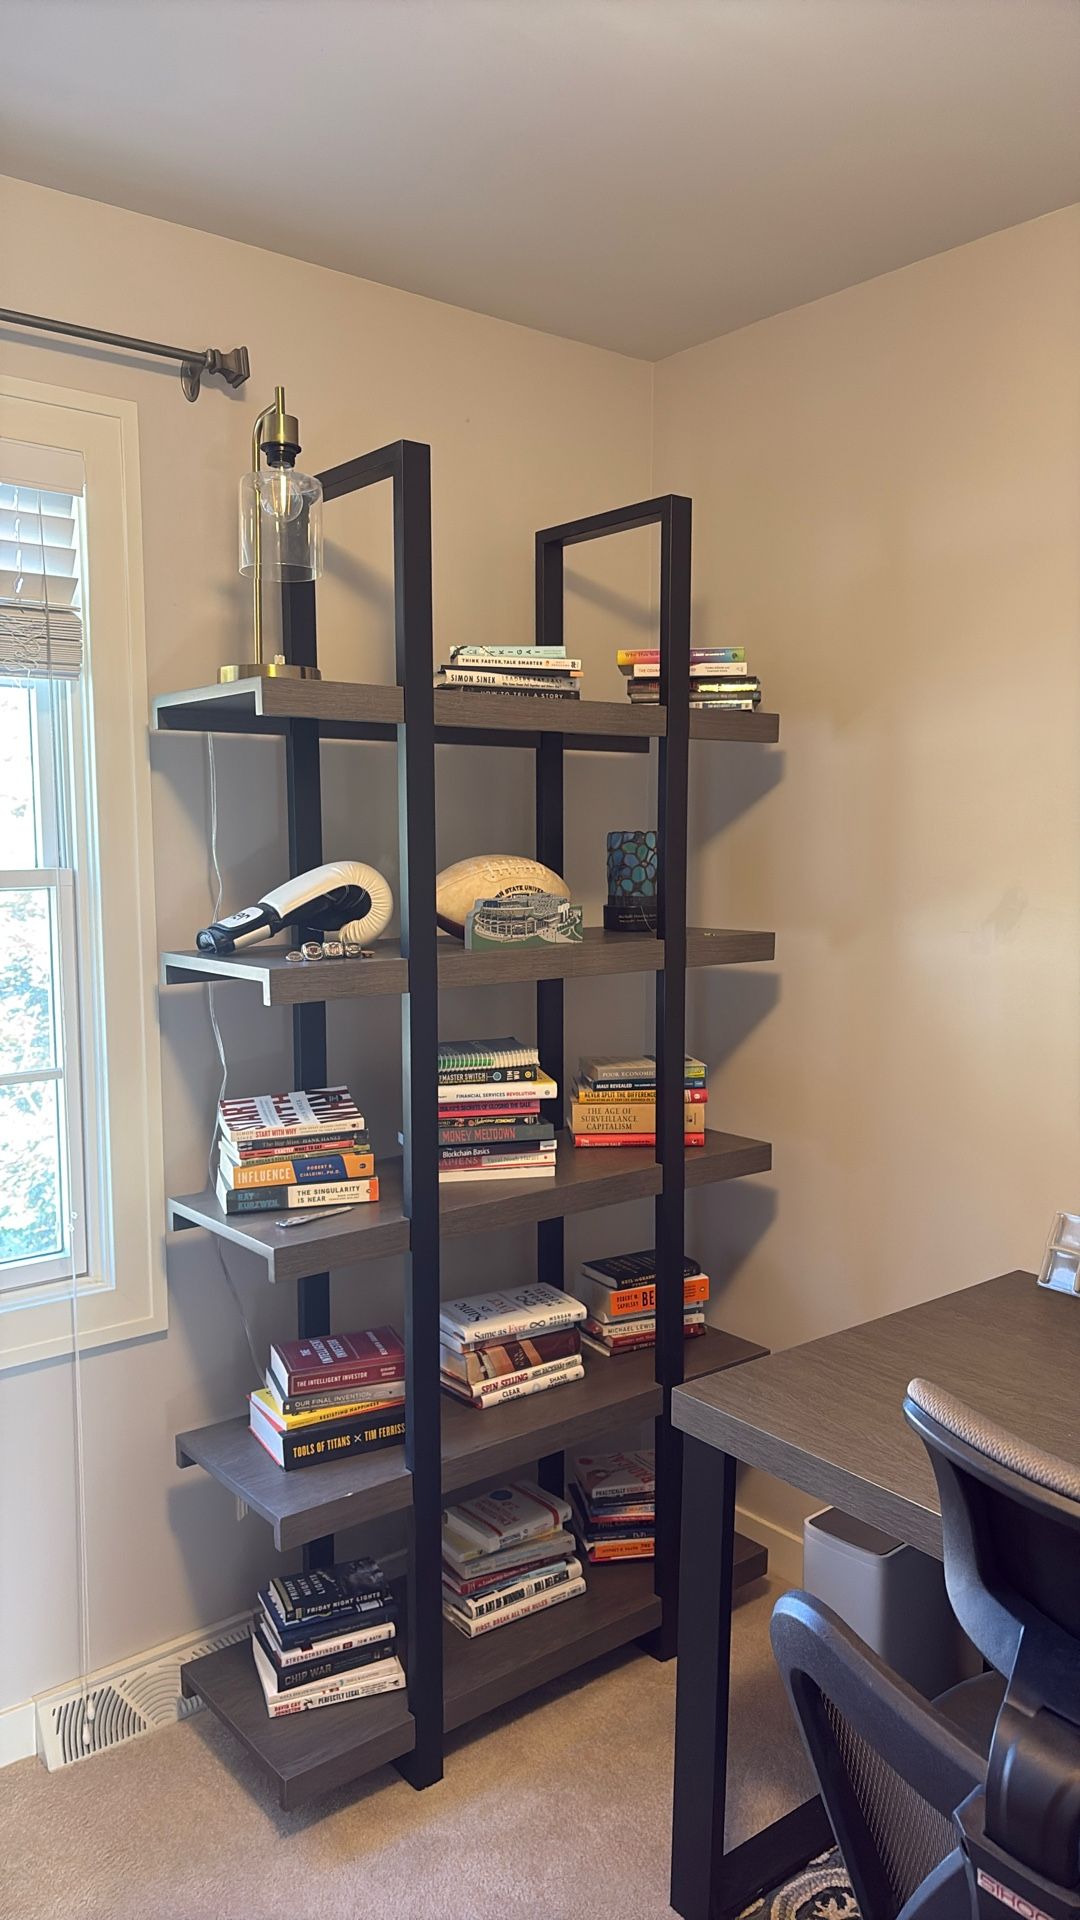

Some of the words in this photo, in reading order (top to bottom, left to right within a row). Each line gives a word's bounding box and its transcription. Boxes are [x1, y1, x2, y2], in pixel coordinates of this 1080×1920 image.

[450, 674, 474, 683] SIMON
[476, 675, 496, 684] SINEK
[504, 885, 524, 895] STATE
[442, 1073, 463, 1081] MASTER
[464, 1072, 486, 1080] SWITCH
[255, 1130, 271, 1138] START
[271, 1129, 285, 1137] WITH
[285, 1127, 297, 1135] WHY
[442, 1129, 472, 1142] MONEY
[474, 1127, 516, 1140] MELTDOWN
[442, 1149, 472, 1158] Blockchain
[472, 1147, 490, 1156] Basics
[440, 1157, 479, 1166] APIENS
[237, 1168, 291, 1184] INFLUENCE
[313, 1185, 361, 1195] SINGULARITY
[307, 1195, 326, 1203] NEAR
[616, 1294, 633, 1303] ROBERT
[548, 1313, 572, 1321] MORGAN
[473, 1329, 497, 1340] Same
[497, 1328, 508, 1336] as
[508, 1323, 528, 1334] Ever
[607, 1326, 634, 1334] MICHAEL
[635, 1323, 655, 1331] LEWIS
[307, 1375, 342, 1386] INTELLIGENT
[342, 1371, 368, 1381] INVESTOR
[481, 1381, 499, 1394] SPIN
[500, 1372, 529, 1387] SELLING
[549, 1374, 567, 1384] SHANE
[294, 1400, 310, 1408] OUR
[311, 1397, 332, 1405] FINAL
[333, 1391, 372, 1402] INVENTION
[501, 1387, 521, 1398] CLEAR
[319, 1409, 348, 1420] RESISTING
[349, 1401, 380, 1412] HAPPINESS
[293, 1443, 315, 1458] TOOLS
[316, 1440, 326, 1453] OF
[326, 1435, 351, 1450] TITANS
[364, 1429, 377, 1442] TIM
[378, 1422, 405, 1438] FERRISS
[306, 1603, 332, 1614] FRIDAY
[332, 1598, 354, 1607] NIGHT
[355, 1591, 381, 1602] LIGHTS
[475, 1605, 485, 1617] THE
[485, 1599, 496, 1612] ART
[492, 1615, 510, 1626] BREAK
[511, 1611, 520, 1619] ALL
[520, 1605, 531, 1615] THE
[531, 1599, 549, 1610] RULES
[284, 1644, 341, 1665] STRENGTHSFINDER
[284, 1671, 308, 1686] CHIP
[309, 1663, 332, 1676] WAR
[317, 1694, 345, 1705] PERFECTLY
[345, 1689, 360, 1699] LEGAL
